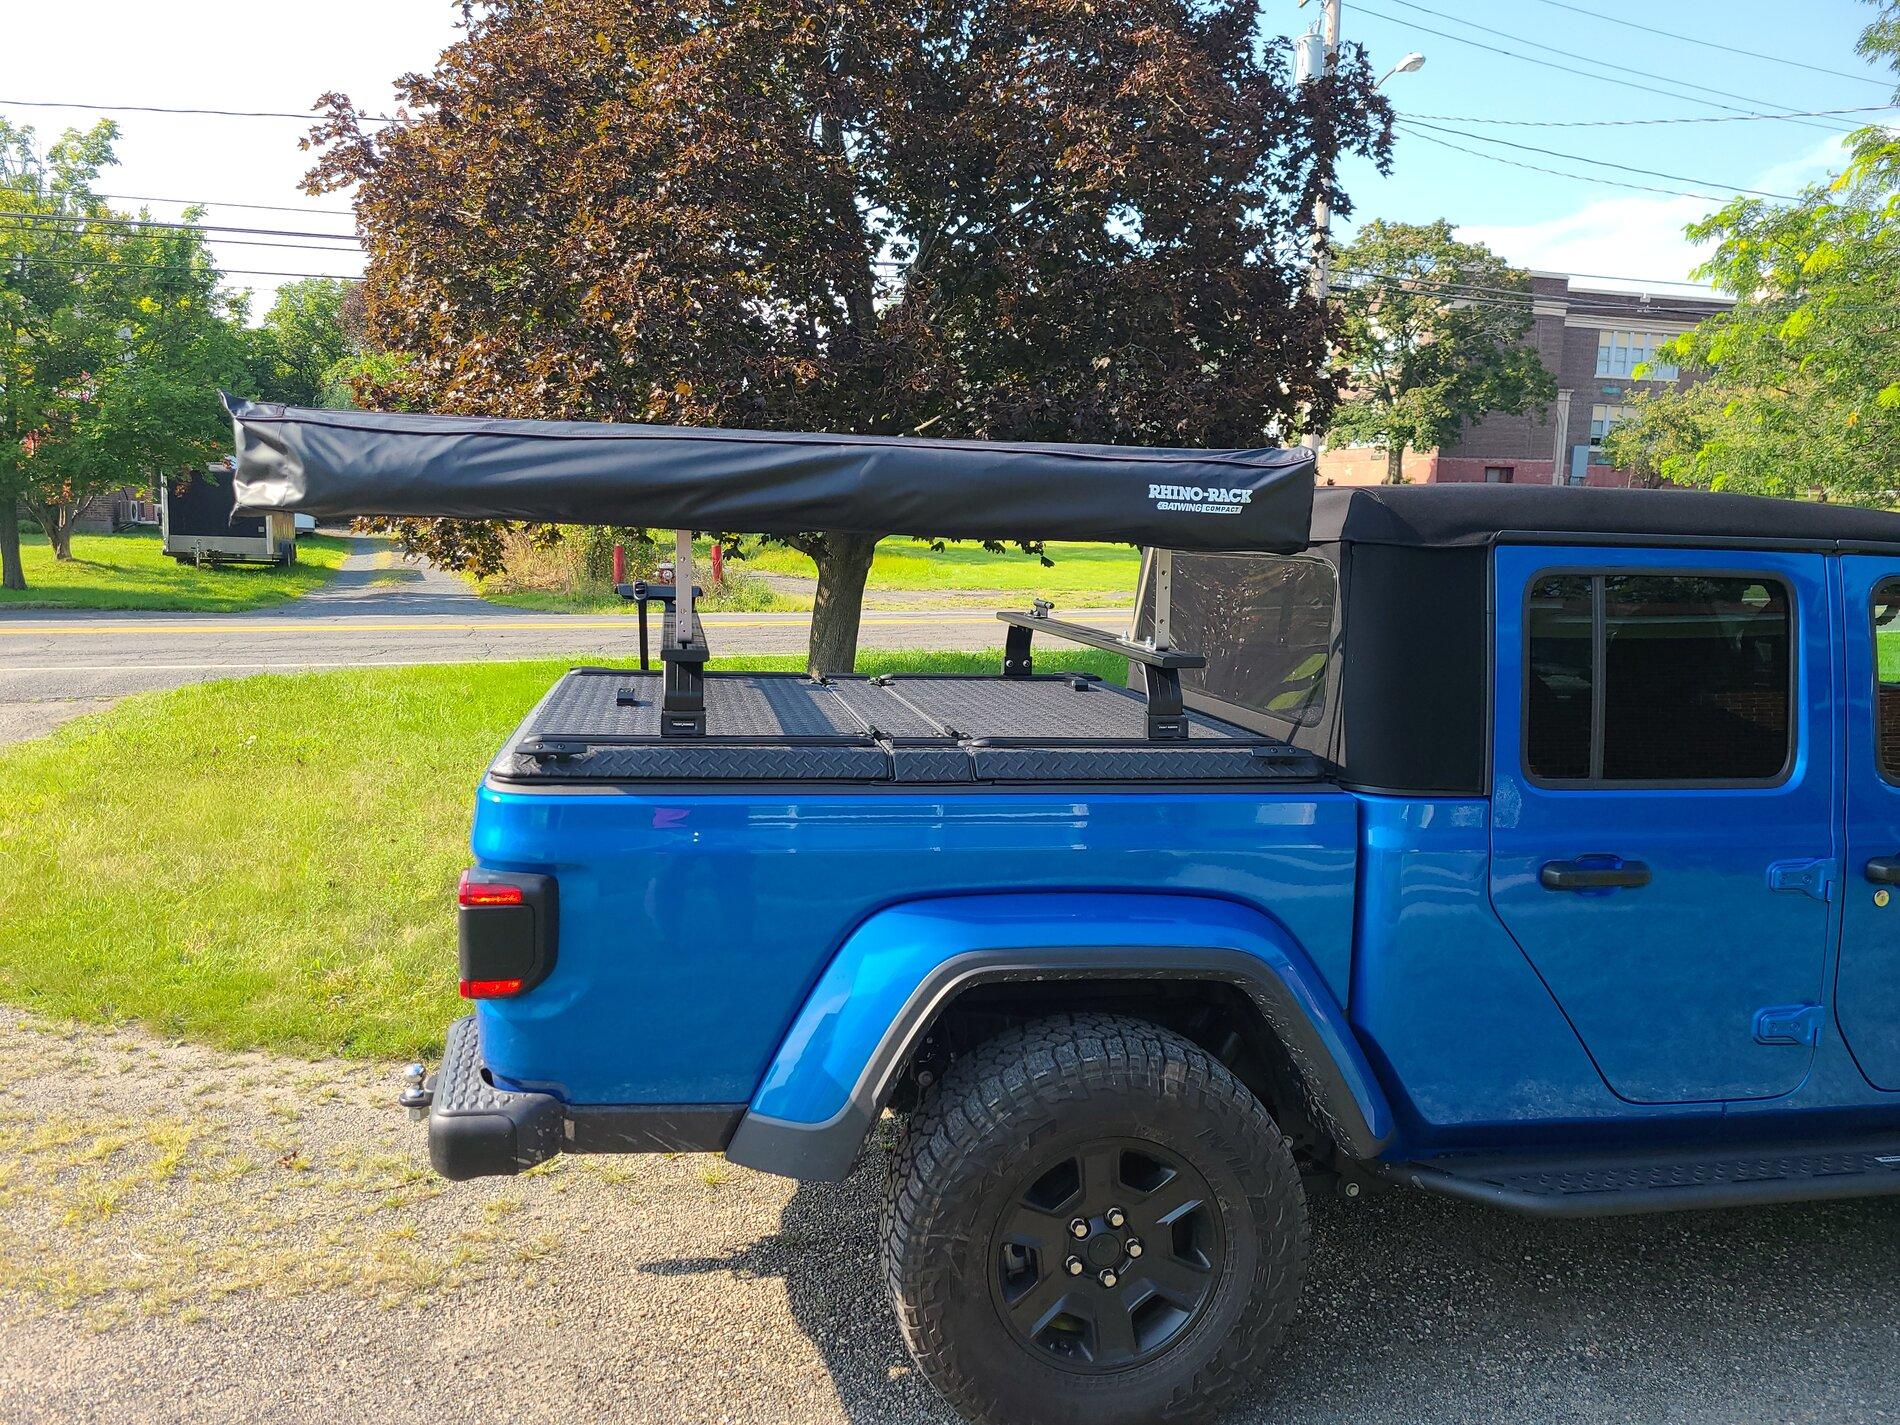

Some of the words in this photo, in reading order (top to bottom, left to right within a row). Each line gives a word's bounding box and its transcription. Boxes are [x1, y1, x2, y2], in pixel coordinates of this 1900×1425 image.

[1148, 484, 1253, 504] RHINO-RACK
[1160, 501, 1202, 513] BATWING
[1204, 505, 1240, 513] COMPACT
